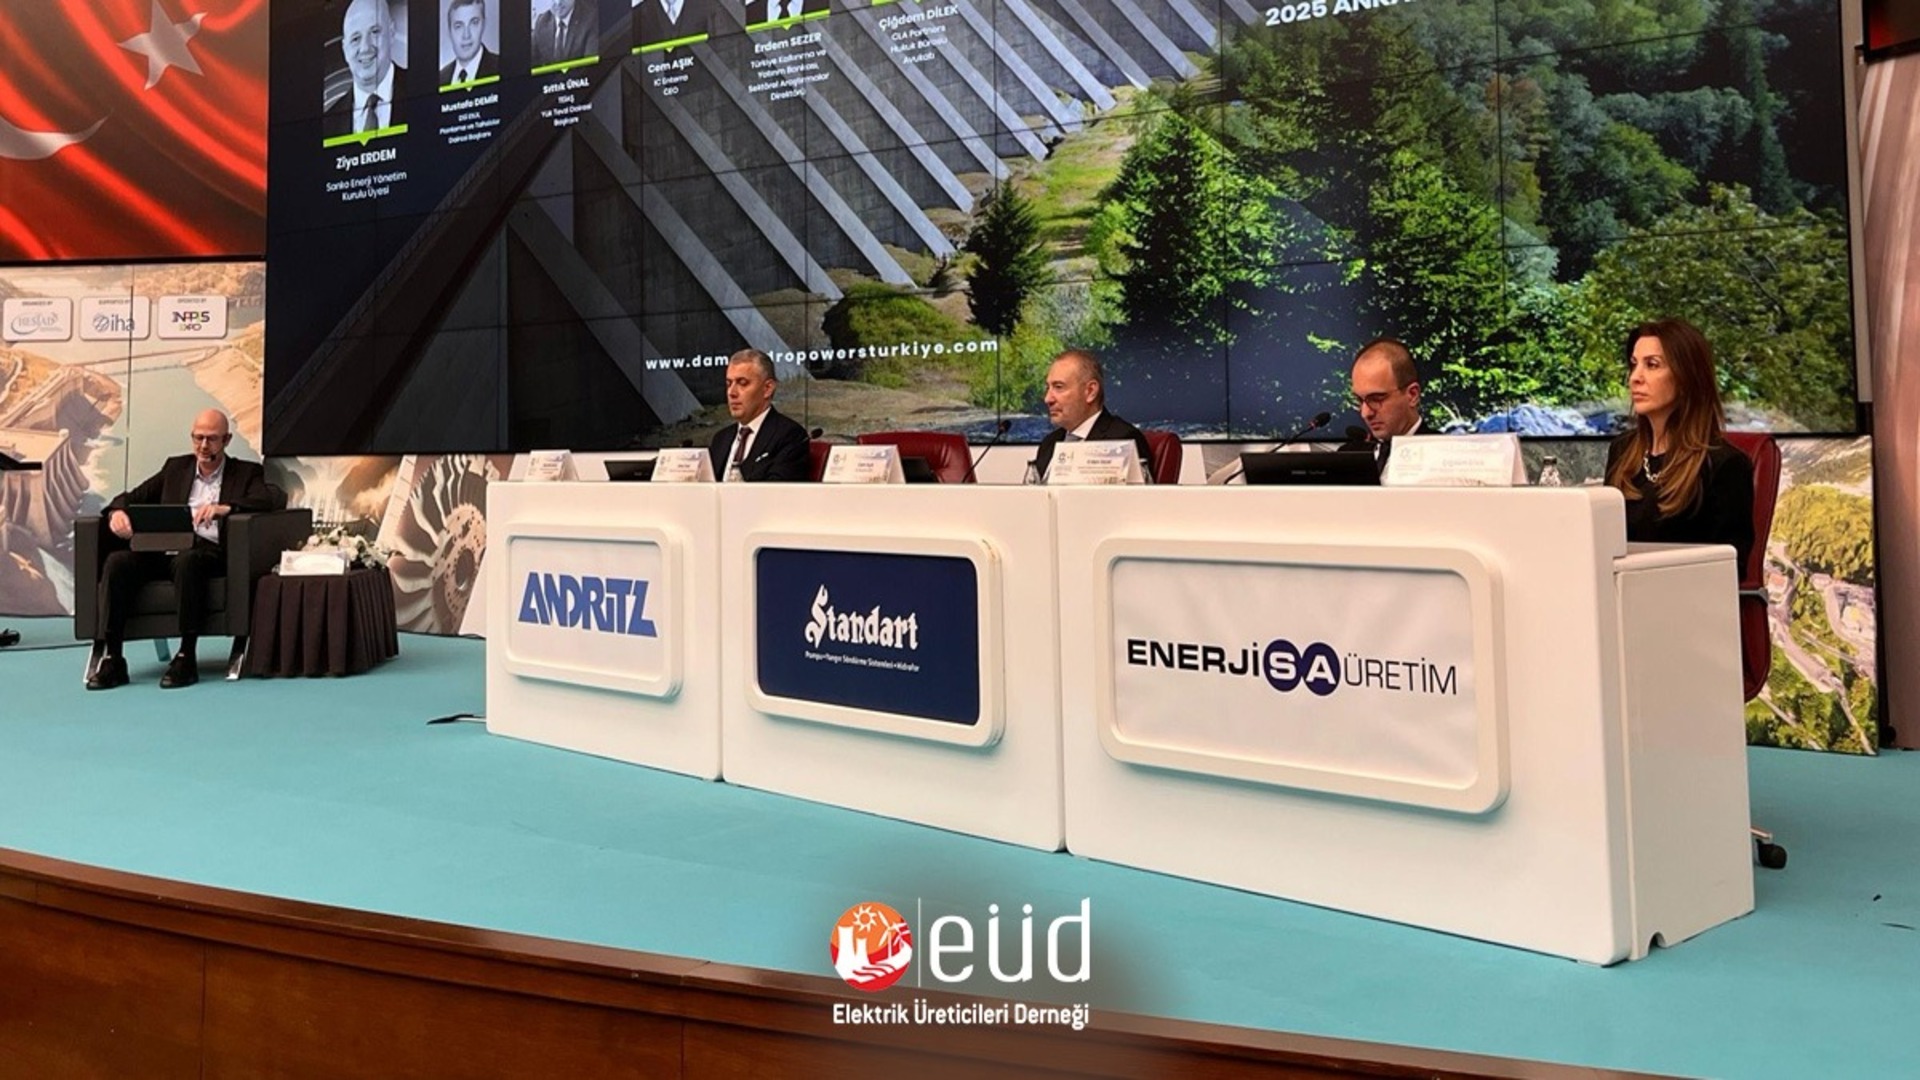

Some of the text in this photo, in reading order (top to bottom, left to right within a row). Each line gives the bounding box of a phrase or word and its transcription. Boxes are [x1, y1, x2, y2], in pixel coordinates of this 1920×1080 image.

[879, 4, 959, 31] Çiğdem DİLEK
[1265, 0, 1328, 26] 2025
[754, 32, 821, 54] Erdem SEZER
[647, 56, 694, 73] Cem AŞIK
[750, 58, 777, 69] Türkiye
[816, 49, 827, 57] ve
[566, 77, 590, 90] ÜNAL
[663, 86, 679, 96] CEO
[441, 93, 499, 113] Mustafa DEMİR
[336, 147, 396, 171] Ziya ERDEM
[325, 171, 407, 192] Sanko Enerji Yönetim
[342, 185, 390, 201] Kurulu Üyesi
[110, 313, 135, 332] iha
[518, 571, 658, 638] ANDRITZ
[804, 584, 918, 650] Standart
[1343, 652, 1458, 696] ÜRETİM
